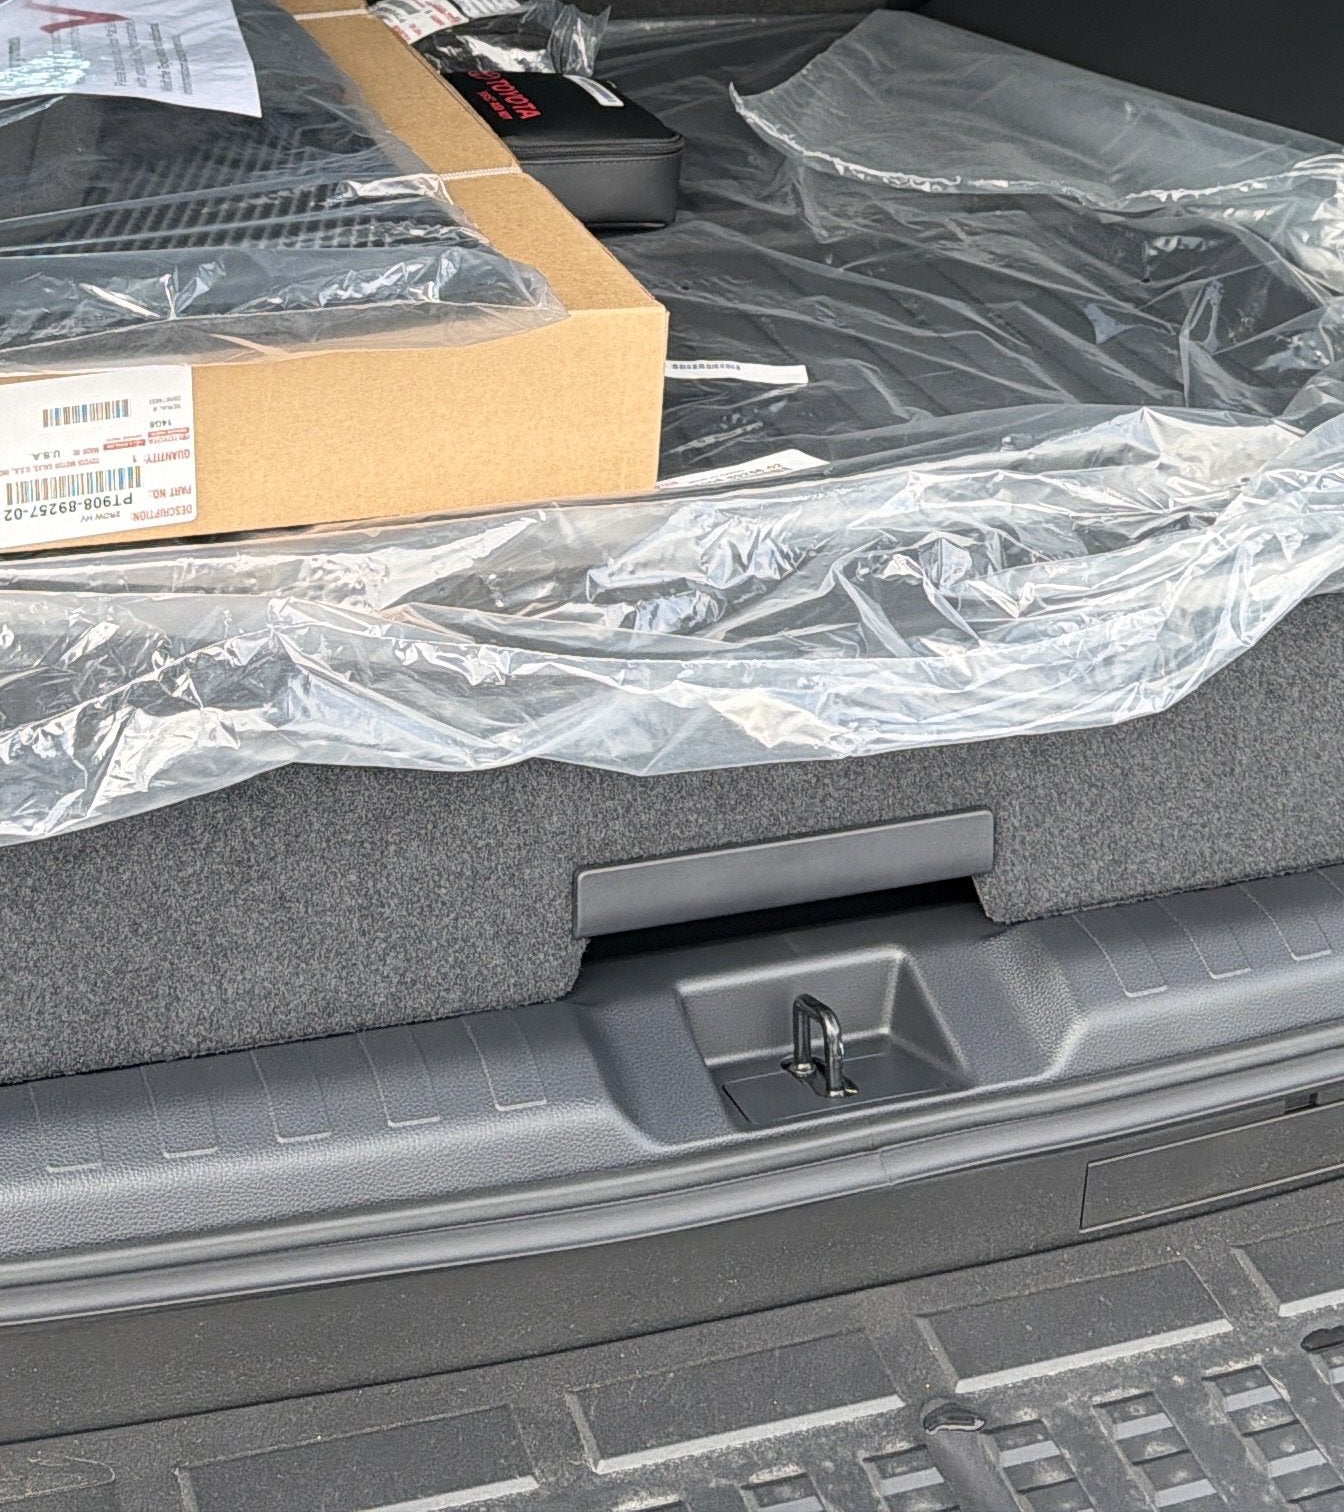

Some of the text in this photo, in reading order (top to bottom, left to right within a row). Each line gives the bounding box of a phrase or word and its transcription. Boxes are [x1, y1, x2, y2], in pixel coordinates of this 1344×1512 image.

[487, 76, 543, 120] TOYOTA
[144, 449, 191, 465] QUANTITY:
[170, 485, 192, 498] PART
[3, 492, 133, 522] PT908-89257-02
[131, 504, 192, 522] DESCRIPTION:
